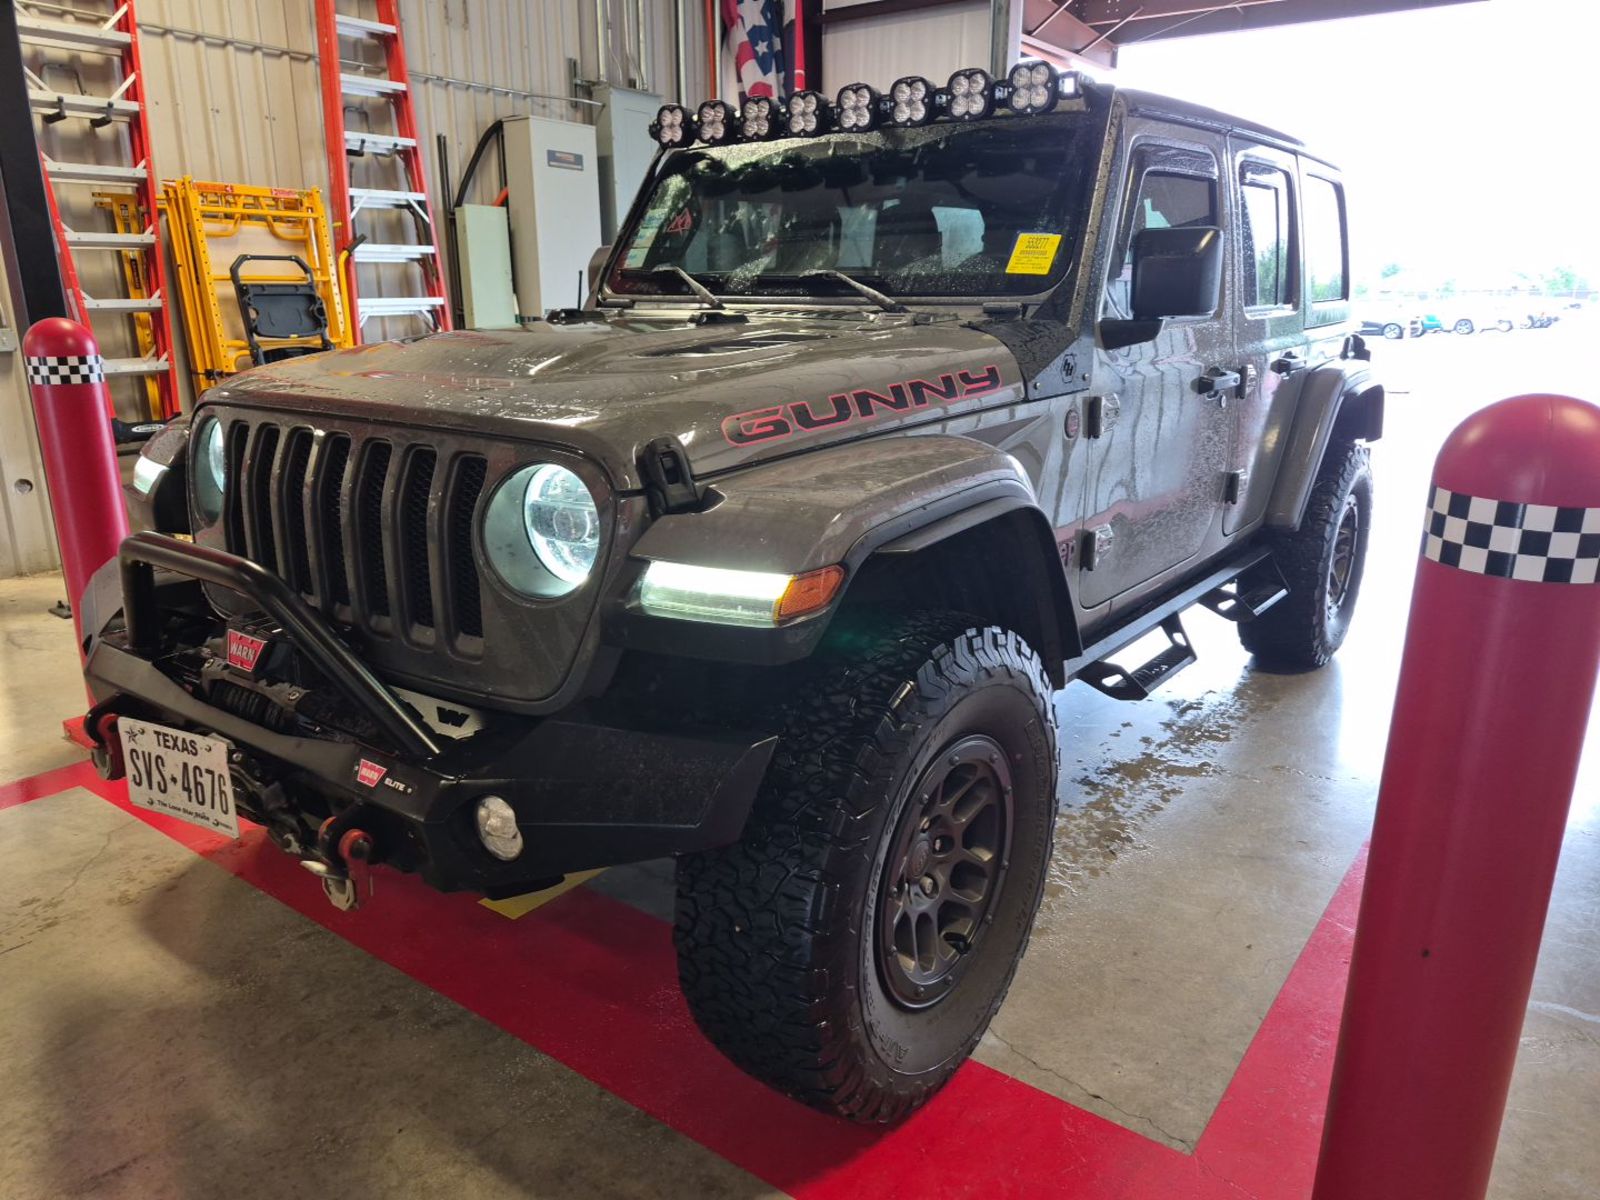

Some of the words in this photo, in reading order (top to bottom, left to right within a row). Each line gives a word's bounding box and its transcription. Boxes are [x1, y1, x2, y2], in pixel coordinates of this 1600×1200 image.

[720, 364, 1002, 448] GUNNY
[230, 641, 256, 661] WARN
[153, 730, 198, 756] TEXAS
[130, 748, 168, 794] SVS
[182, 762, 229, 815] 4676
[384, 777, 406, 791] ELITE
[168, 803, 181, 812] Lone
[182, 807, 193, 817] Star
[194, 811, 210, 822] State
